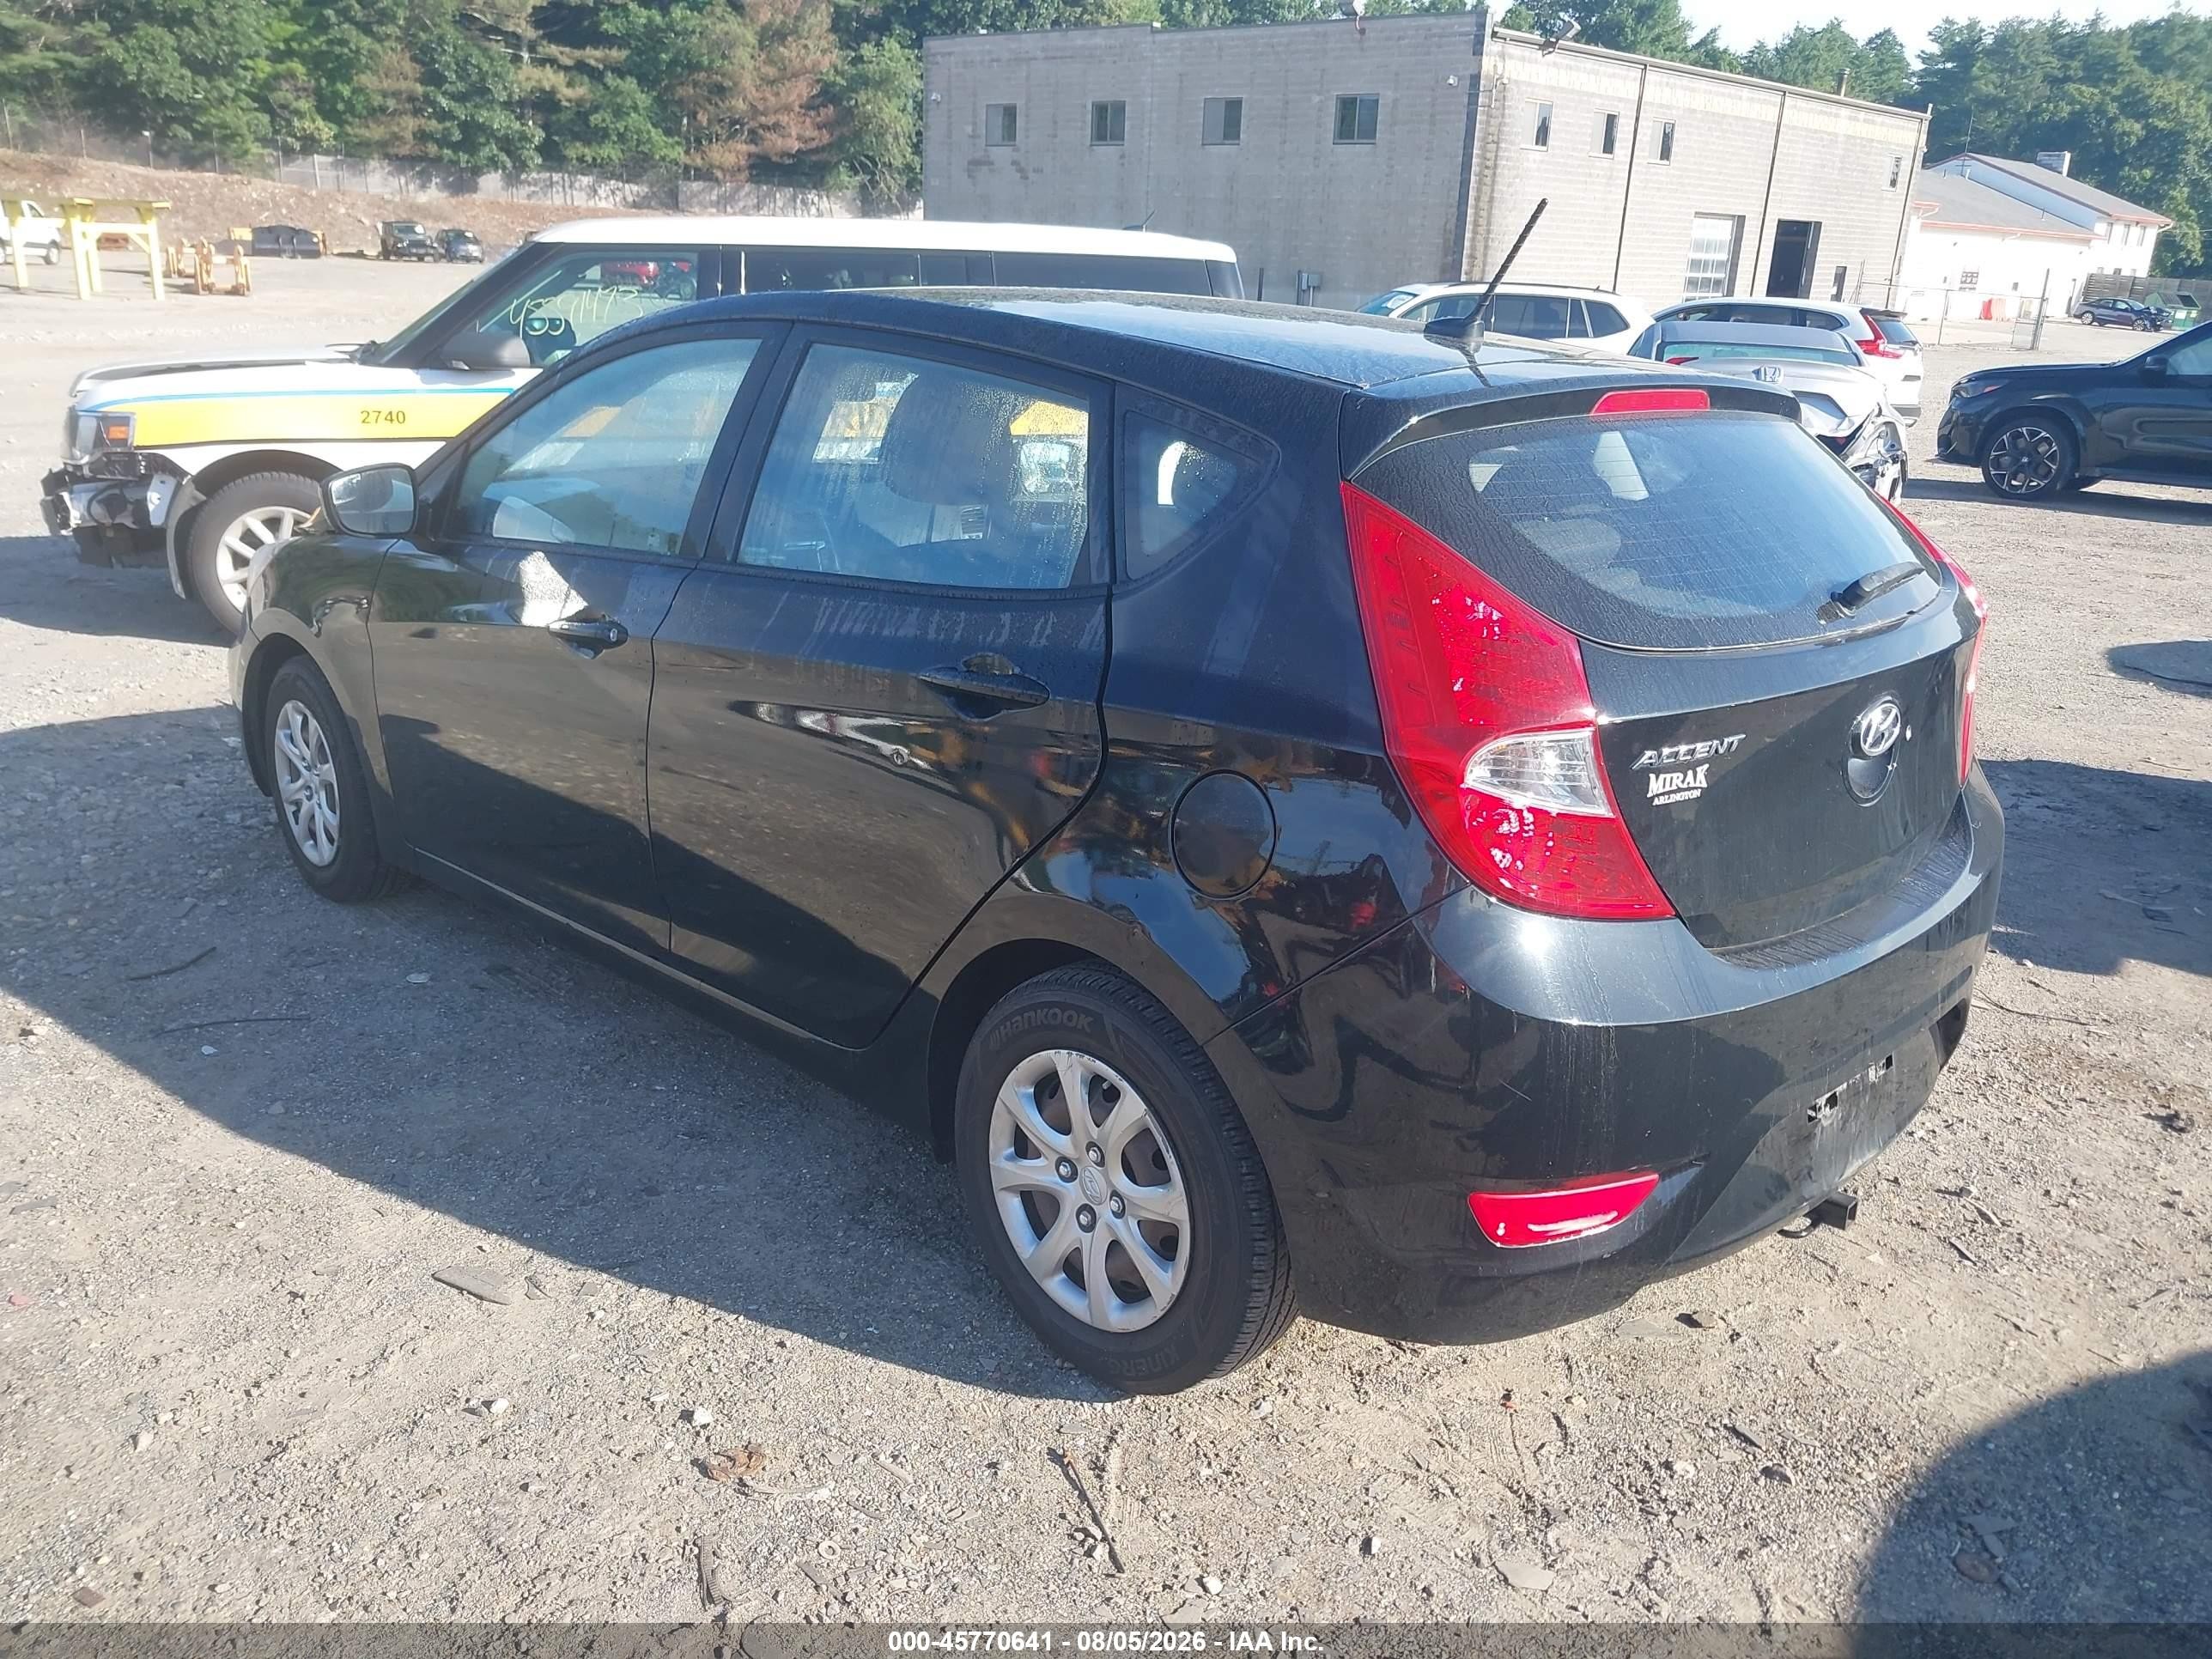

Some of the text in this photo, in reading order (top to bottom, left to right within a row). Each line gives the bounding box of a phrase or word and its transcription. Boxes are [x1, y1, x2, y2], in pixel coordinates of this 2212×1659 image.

[360, 410, 406, 424] 2740
[1631, 733, 1747, 770] ACCENT
[1647, 763, 1710, 798] MIRAK
[1652, 788, 1702, 806] ARLINGTON
